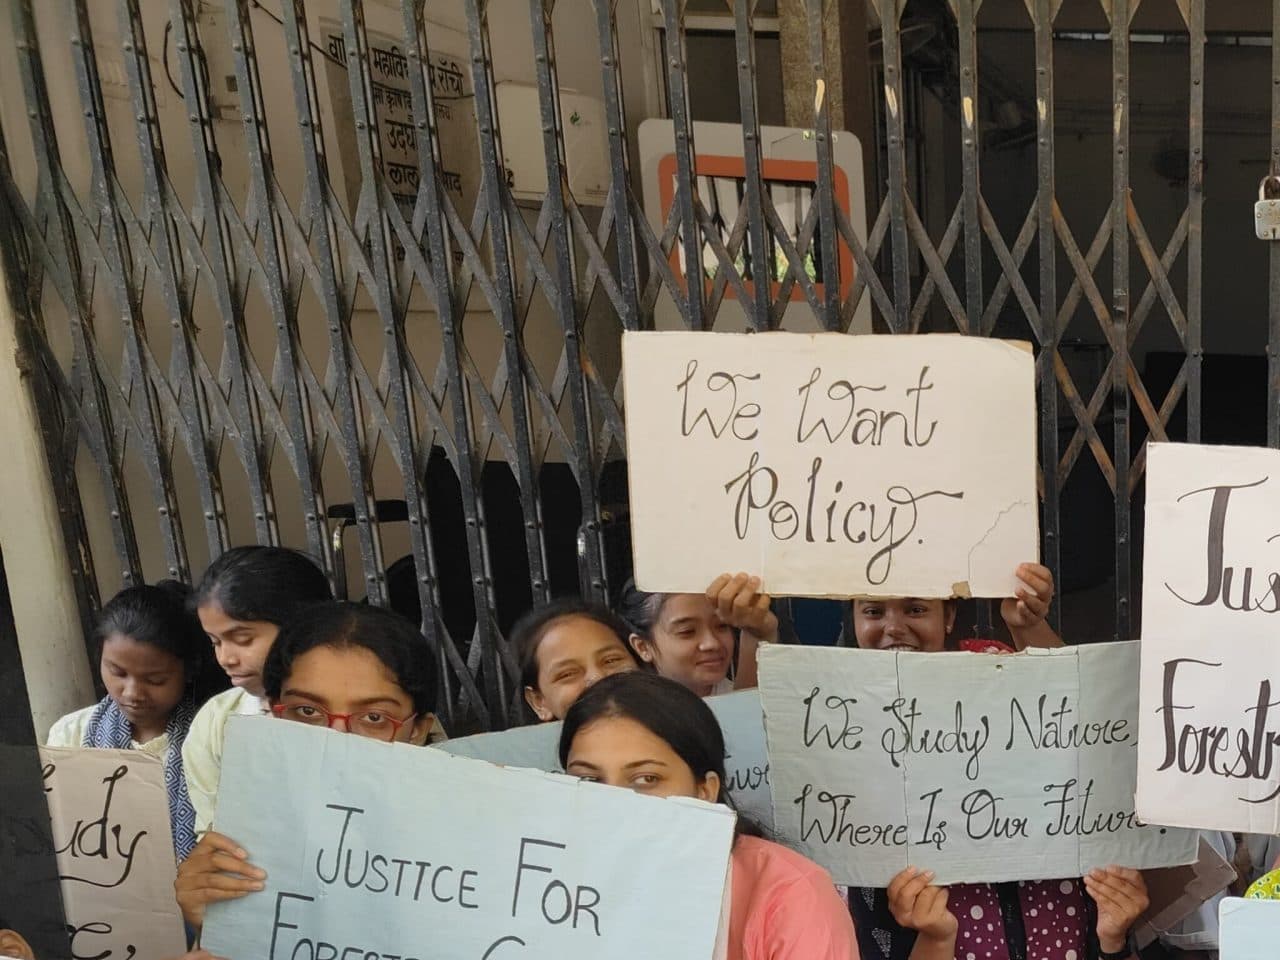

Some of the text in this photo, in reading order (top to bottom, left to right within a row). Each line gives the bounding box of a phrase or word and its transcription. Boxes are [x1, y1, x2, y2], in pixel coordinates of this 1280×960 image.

[677, 359, 939, 448] We Want
[725, 451, 965, 585] Policy.
[803, 686, 863, 751] We
[881, 697, 990, 781] Study
[794, 783, 909, 846] Where
[915, 787, 947, 851] Is
[961, 788, 1028, 840] Our
[315, 803, 602, 937] JUSTICE FOR
